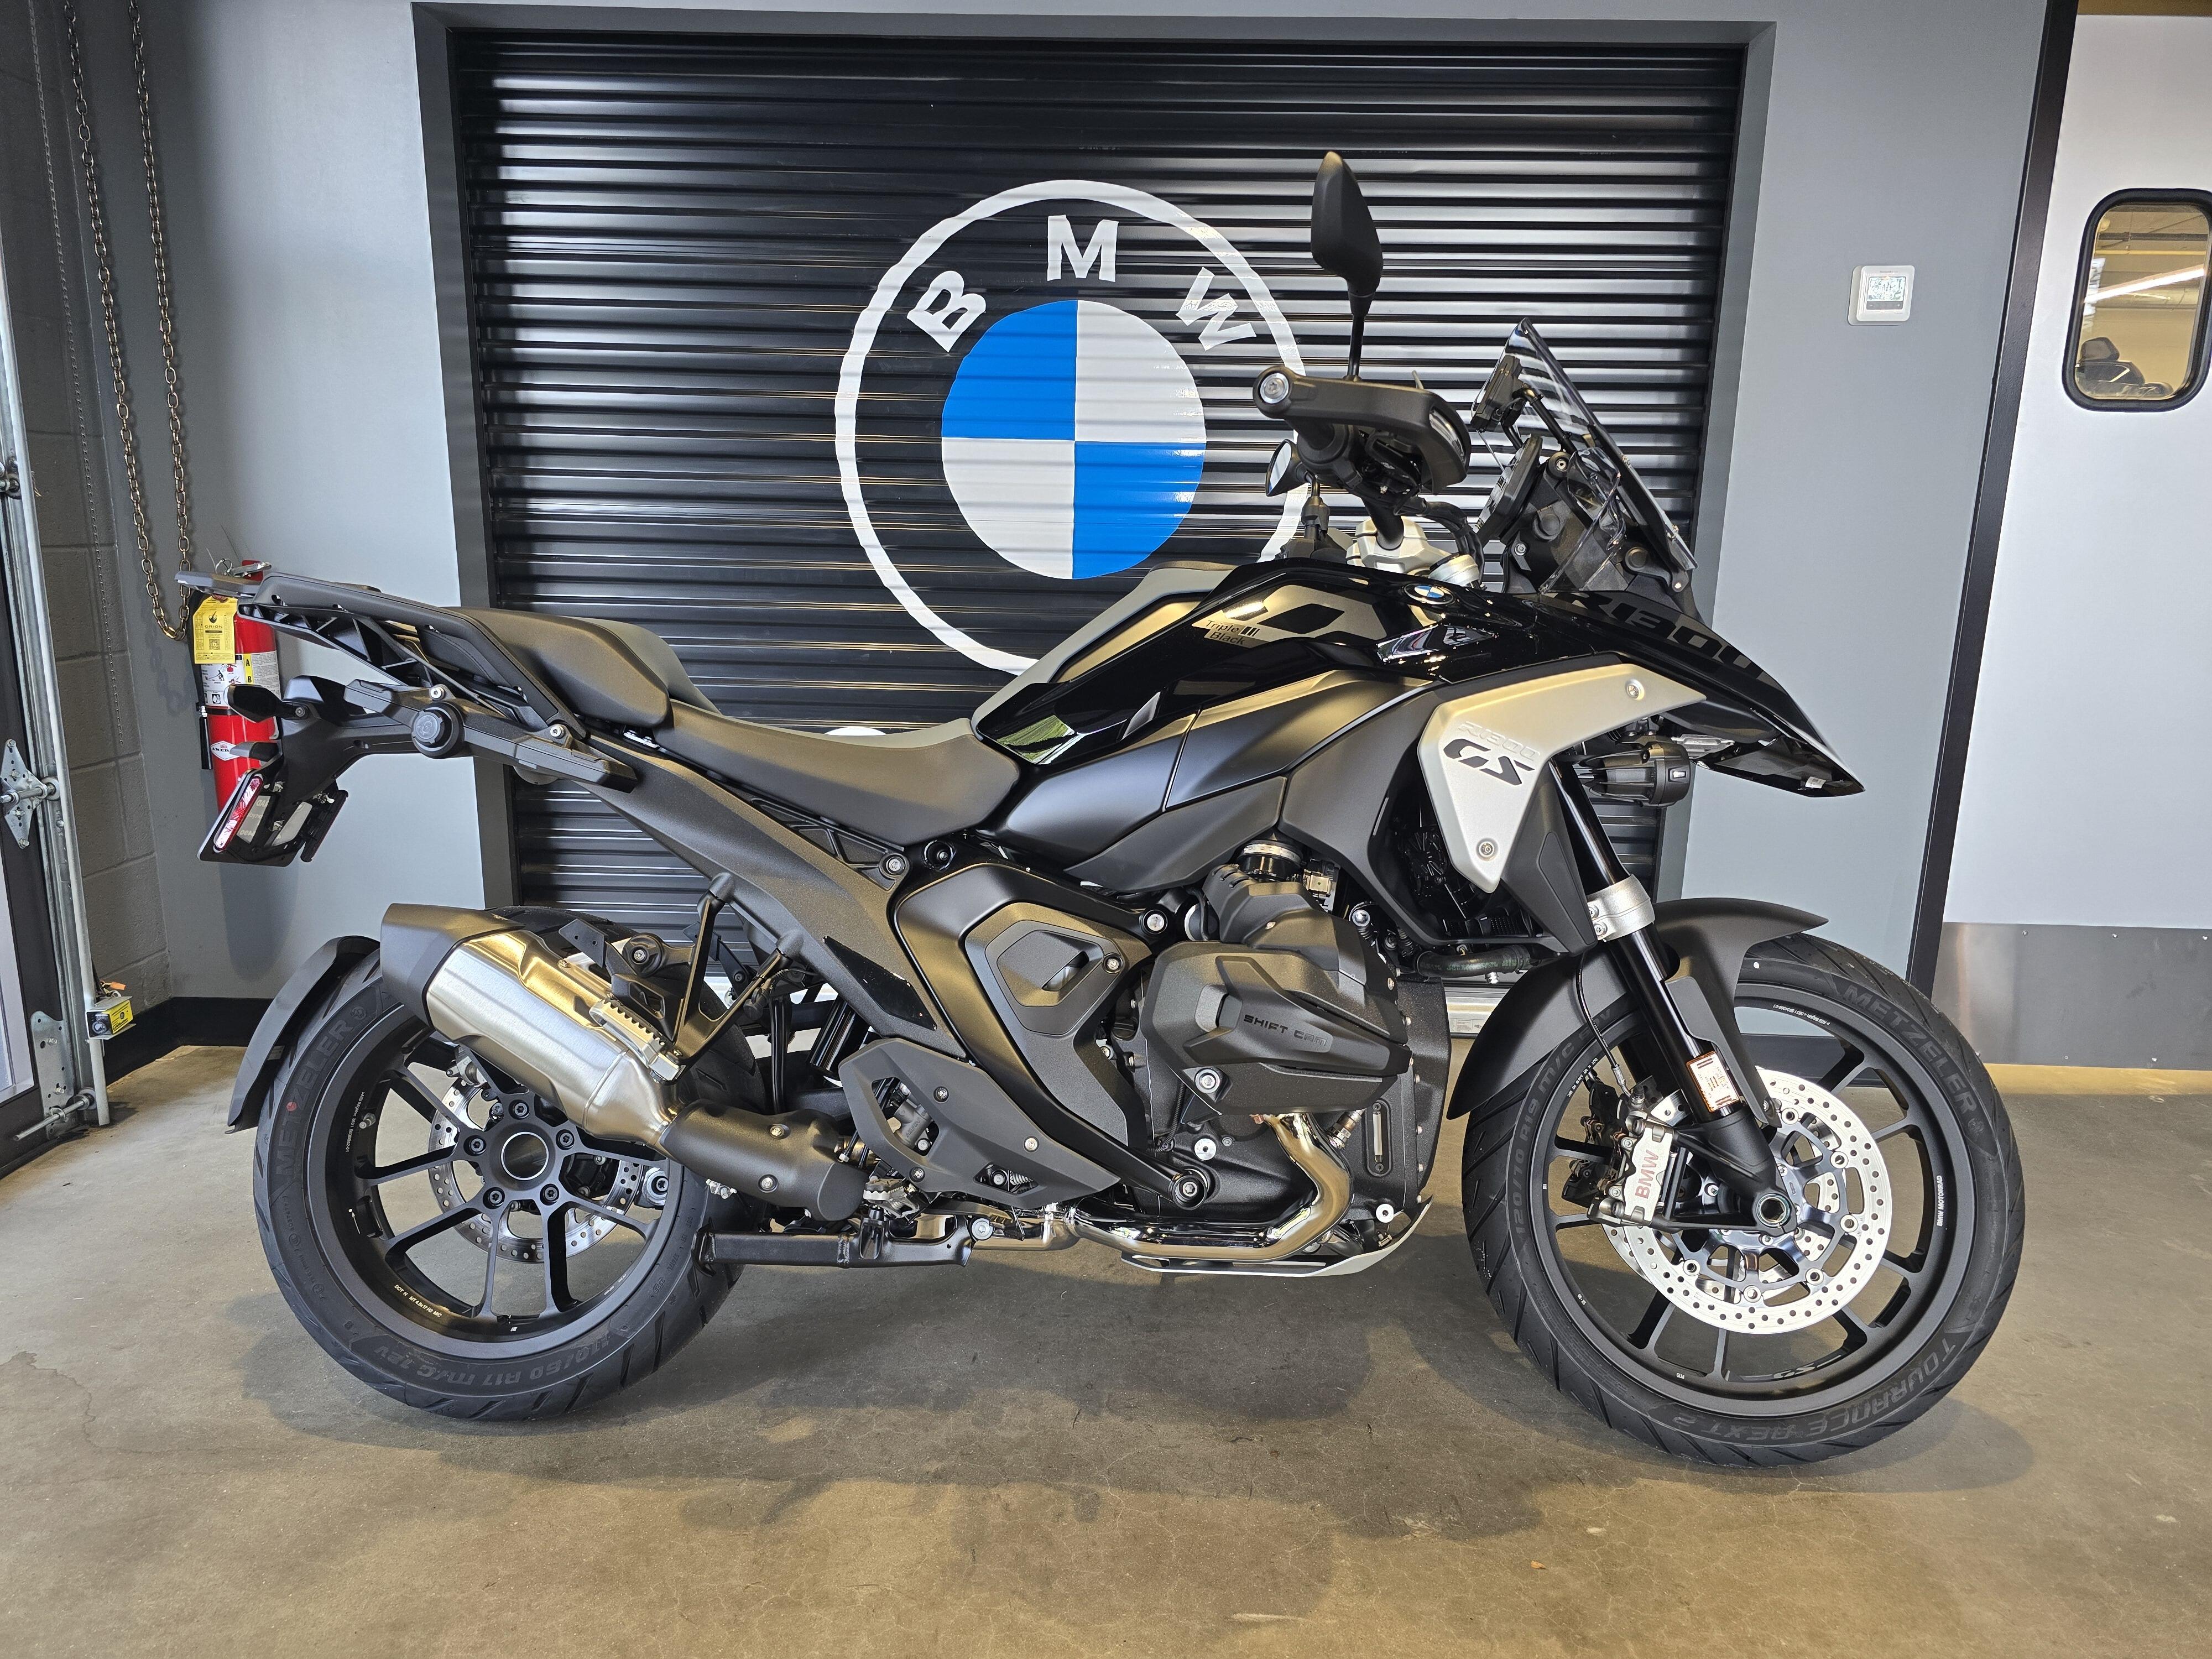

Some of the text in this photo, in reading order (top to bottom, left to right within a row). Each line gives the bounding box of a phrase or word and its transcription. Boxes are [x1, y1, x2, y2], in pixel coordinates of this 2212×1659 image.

[907, 215, 1256, 352] BMW
[1206, 620, 1239, 633] Triple
[1209, 631, 1245, 645] Black
[1443, 738, 1536, 786] GS
[1458, 721, 1541, 761] R1300
[1244, 1014, 1327, 1046] SHIFT CAM
[1844, 984, 1978, 1114] METZELER
[276, 1019, 337, 1175] METZELER
[1520, 1099, 1541, 1140] R19
[1538, 1042, 1575, 1093] M/C
[1635, 1149, 1659, 1199] BMW
[393, 1284, 405, 1293] DOT
[482, 1371, 521, 1387] R17
[1806, 1337, 1956, 1437] TOURANCE
